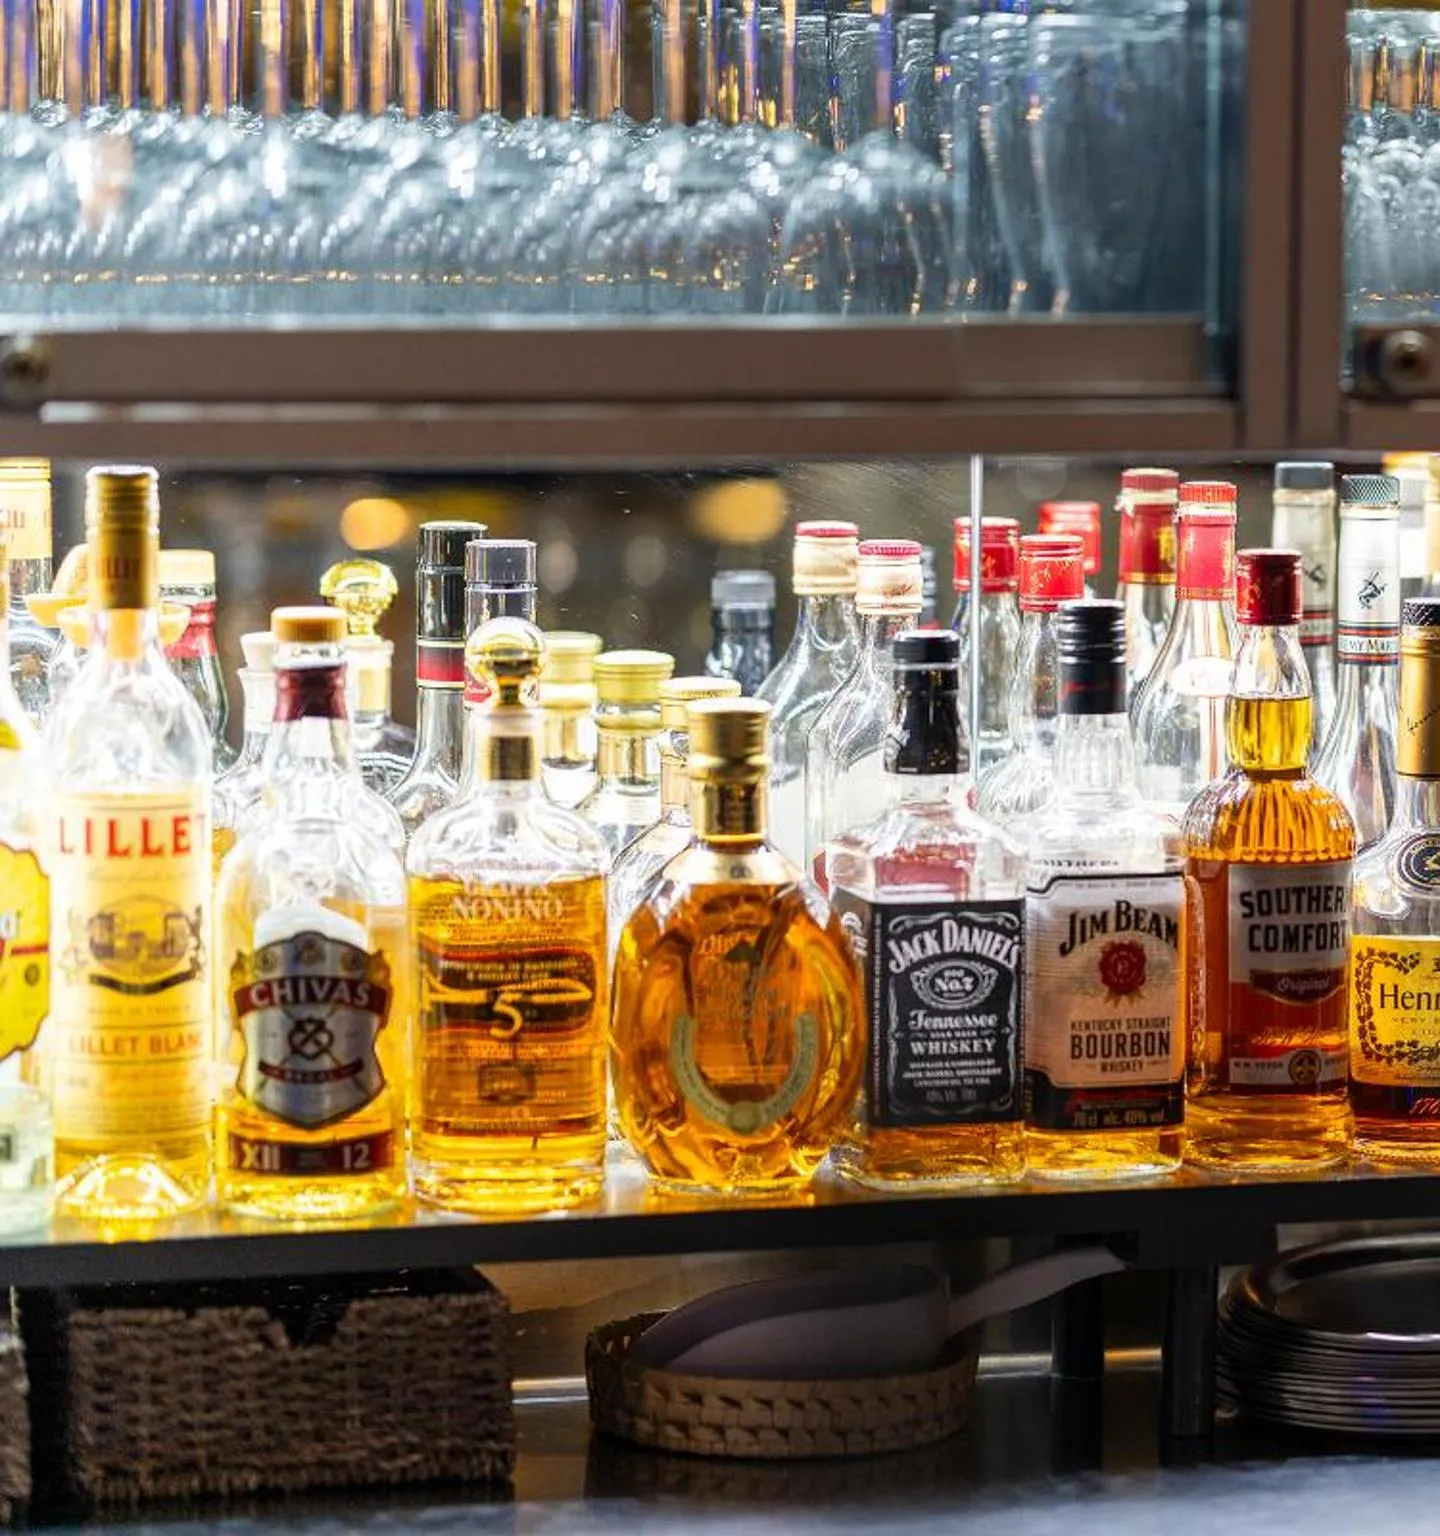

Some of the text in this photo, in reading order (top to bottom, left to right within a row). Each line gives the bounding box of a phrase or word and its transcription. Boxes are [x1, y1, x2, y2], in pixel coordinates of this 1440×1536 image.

[1240, 885, 1346, 918] SOUTHER
[1060, 900, 1178, 957] JIM BEAM
[887, 927, 939, 974] JACK
[251, 979, 371, 1006] CHIVAS
[908, 1010, 998, 1030] Tennessee
[1071, 1016, 1170, 1031] KENTUCKY STRAIGHT
[910, 1039, 996, 1056] WHISKEY
[1071, 1031, 1170, 1060] BOURBON
[1101, 1060, 1143, 1073] WHISKEY
[240, 1142, 371, 1171] XII 12
